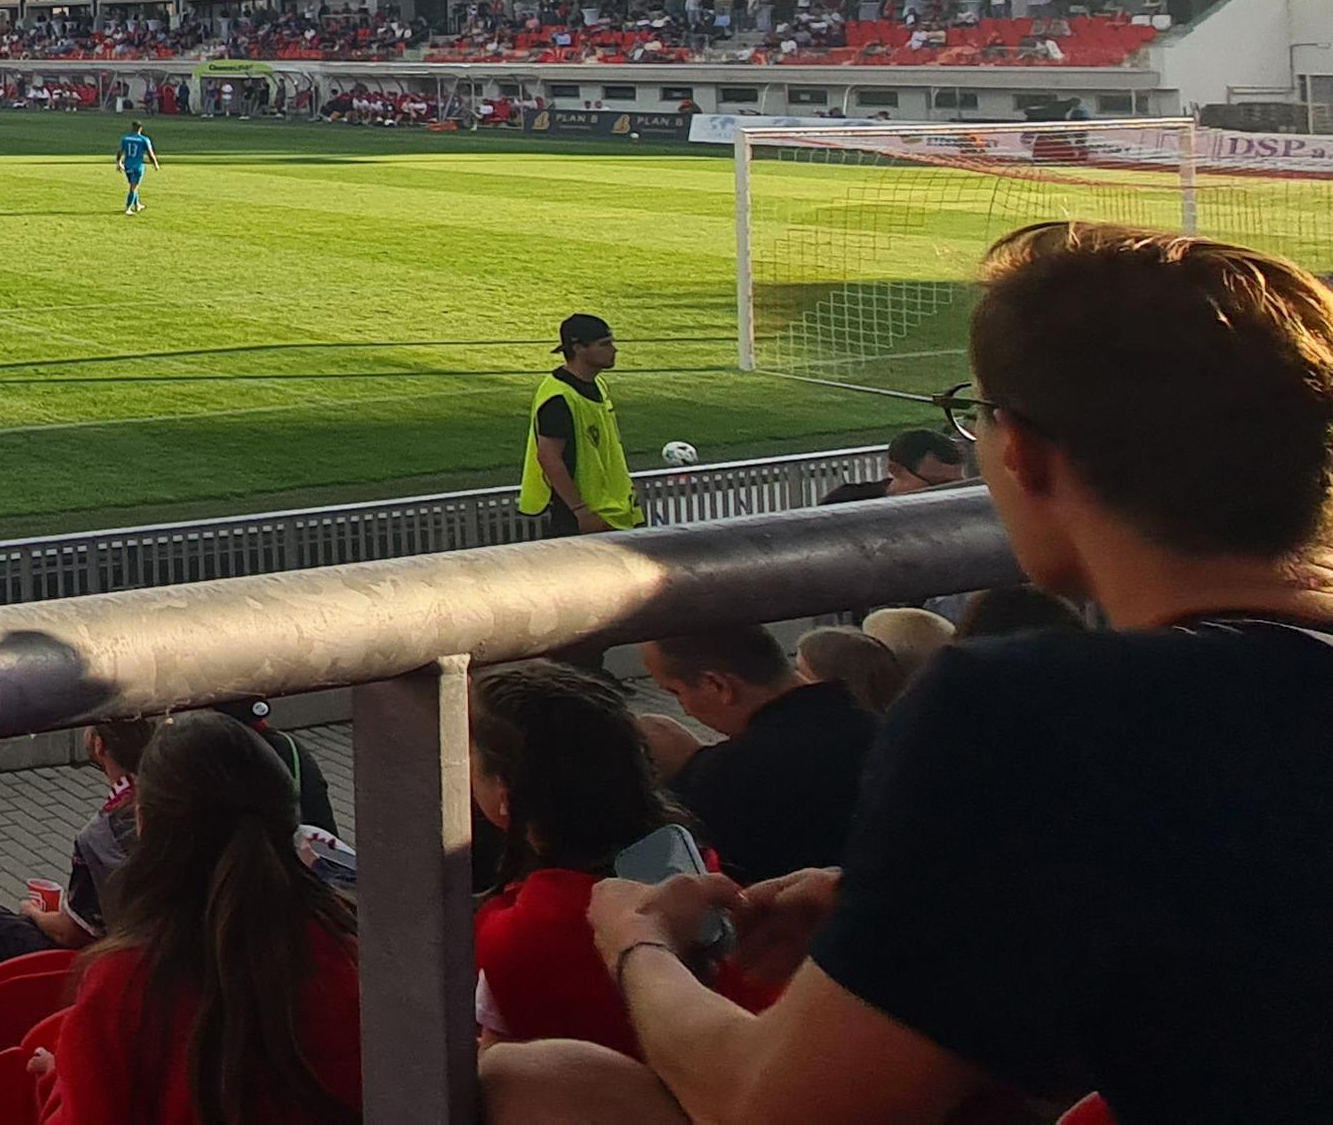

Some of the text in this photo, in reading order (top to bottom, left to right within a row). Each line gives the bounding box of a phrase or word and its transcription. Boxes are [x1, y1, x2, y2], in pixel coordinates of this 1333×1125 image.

[554, 114, 586, 124] PLAN
[636, 116, 669, 126] PLAN
[128, 143, 139, 157] 13
[1228, 137, 1306, 158] DSP
